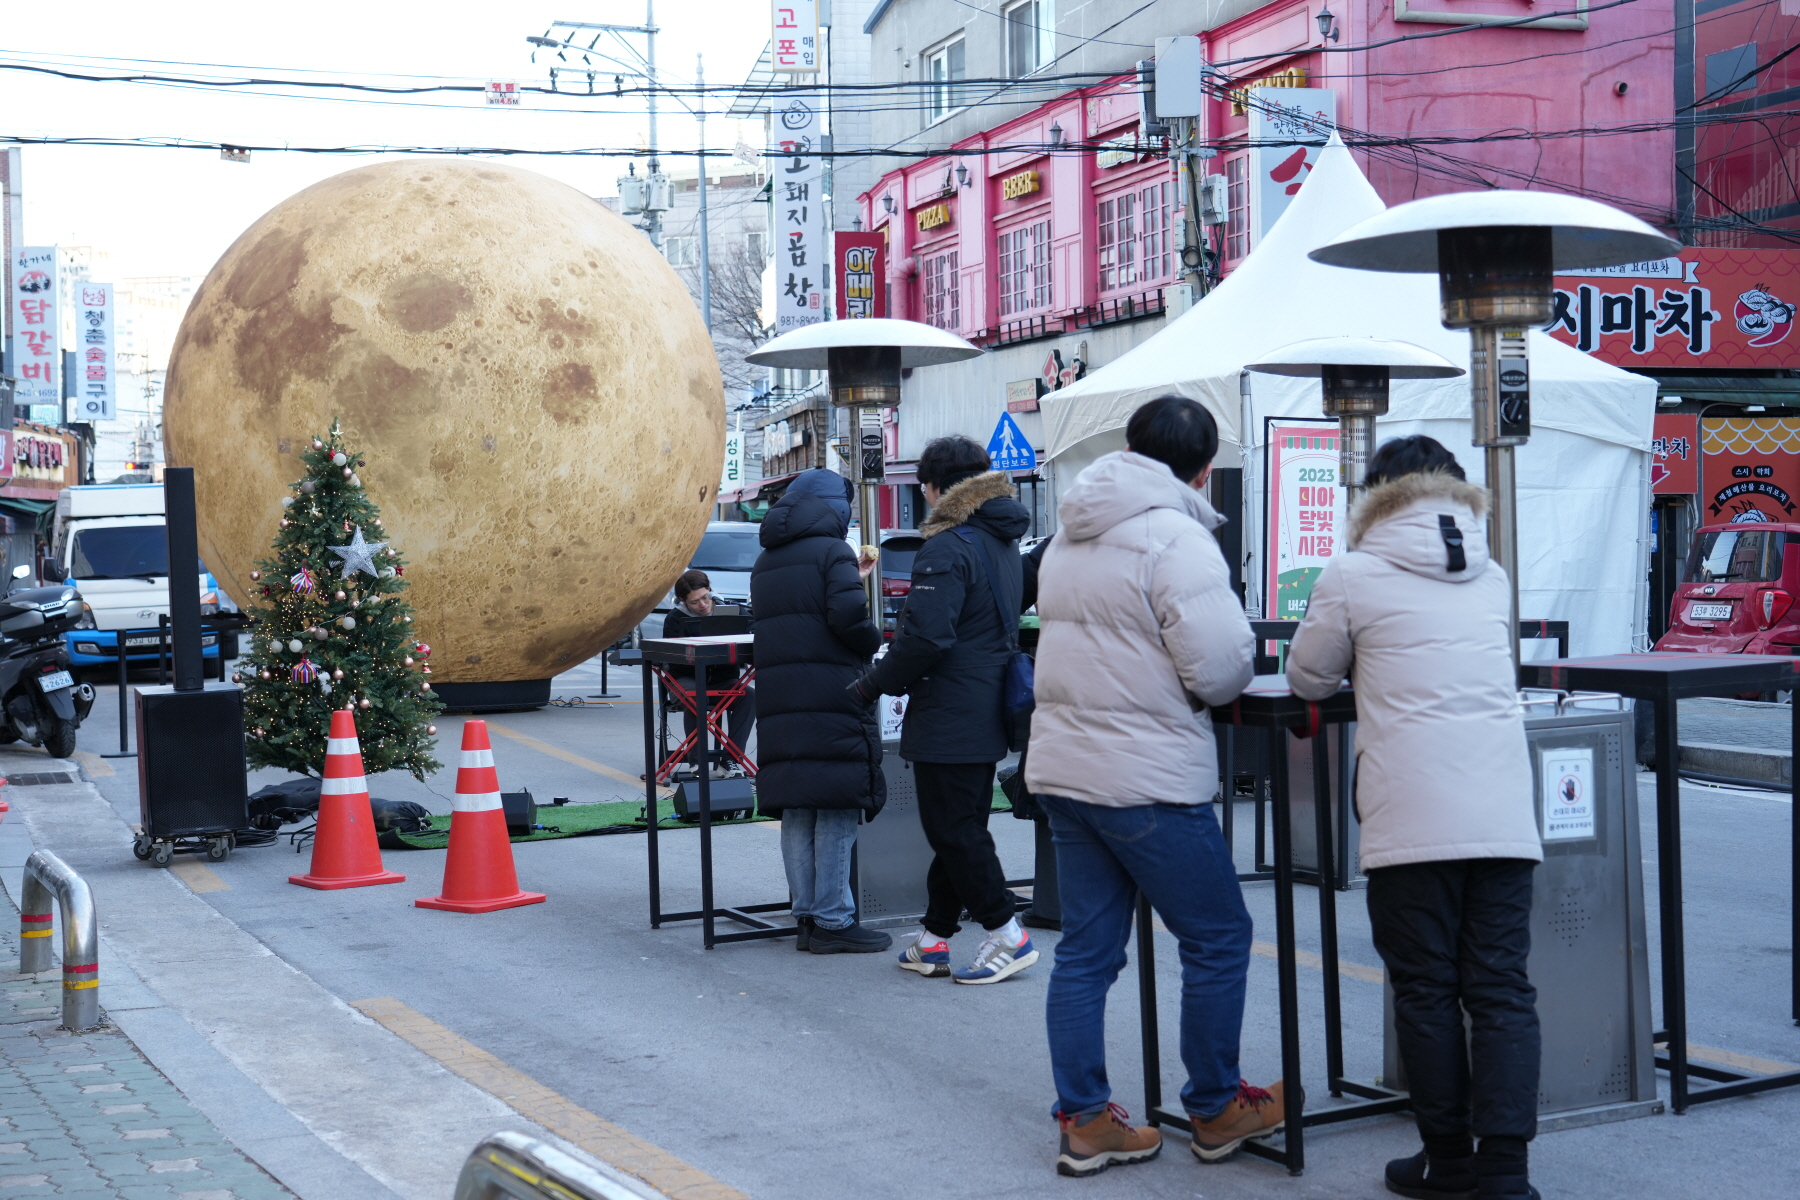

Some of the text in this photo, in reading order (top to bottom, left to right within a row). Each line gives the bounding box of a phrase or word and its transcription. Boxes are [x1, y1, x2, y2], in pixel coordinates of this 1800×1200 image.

[803, 36, 814, 65] 매입
[1002, 171, 1037, 200] BEER
[916, 204, 947, 231] PIZZA
[20, 299, 53, 383] 닭갈비
[992, 459, 1029, 469] 횡단보도
[1735, 467, 1771, 476] 스시 막회
[1298, 468, 1335, 482] 2023
[1299, 487, 1335, 507] 미아
[1718, 482, 1787, 502] 제철해산물 요리포차
[1299, 510, 1334, 532] 달빛
[1298, 535, 1334, 557] 시장
[1710, 606, 1728, 617] 3295
